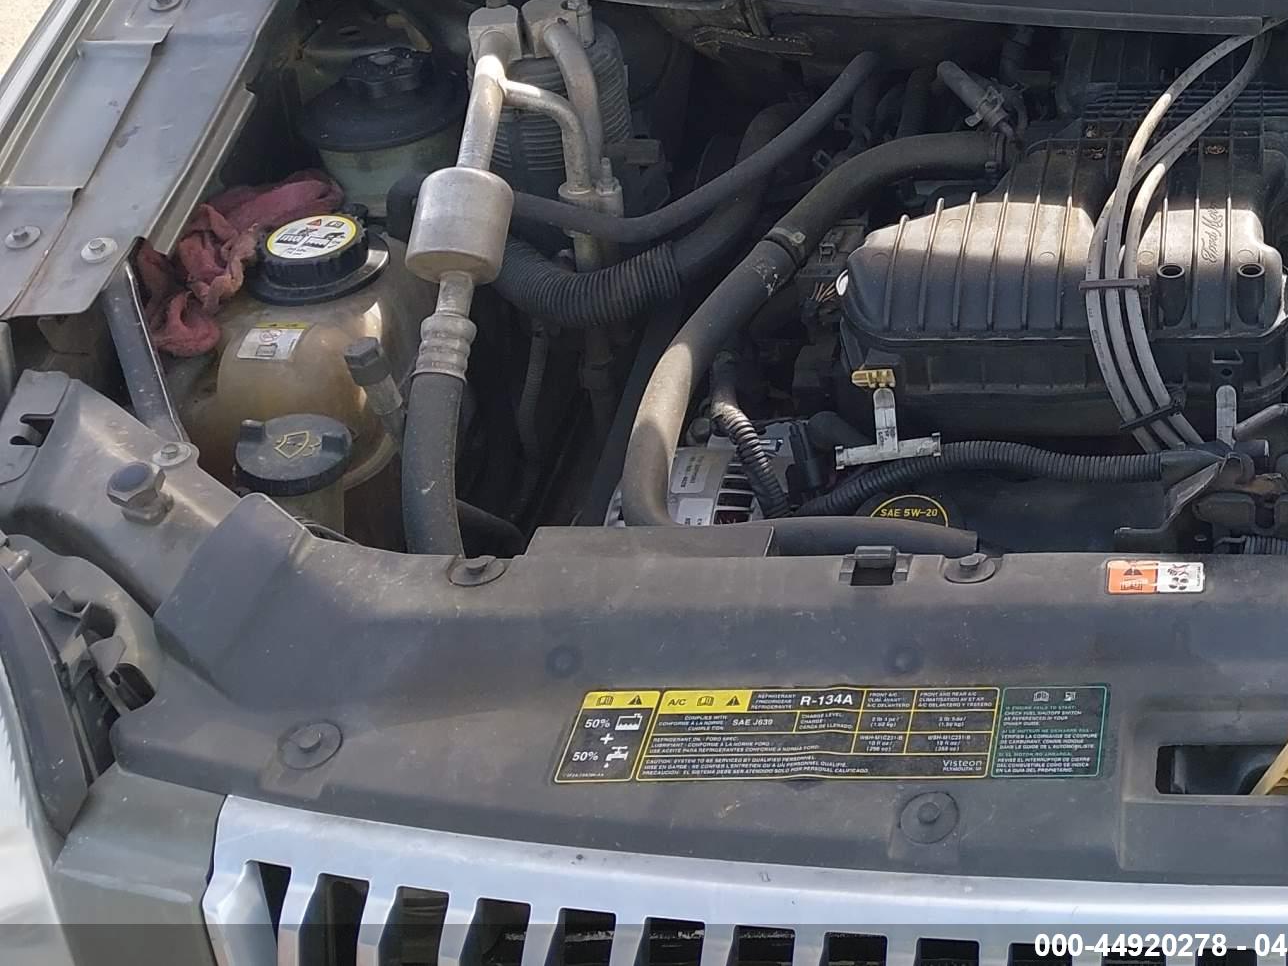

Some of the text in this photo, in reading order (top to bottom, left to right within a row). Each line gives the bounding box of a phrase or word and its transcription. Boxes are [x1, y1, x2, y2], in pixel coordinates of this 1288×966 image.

[881, 508, 938, 517] SAE 5W-20
[668, 698, 687, 706] A/C
[800, 694, 853, 706] R-134A
[584, 718, 611, 729] 50%
[753, 718, 774, 726] J639
[571, 751, 599, 762] 50%
[943, 759, 982, 767] Visteon
